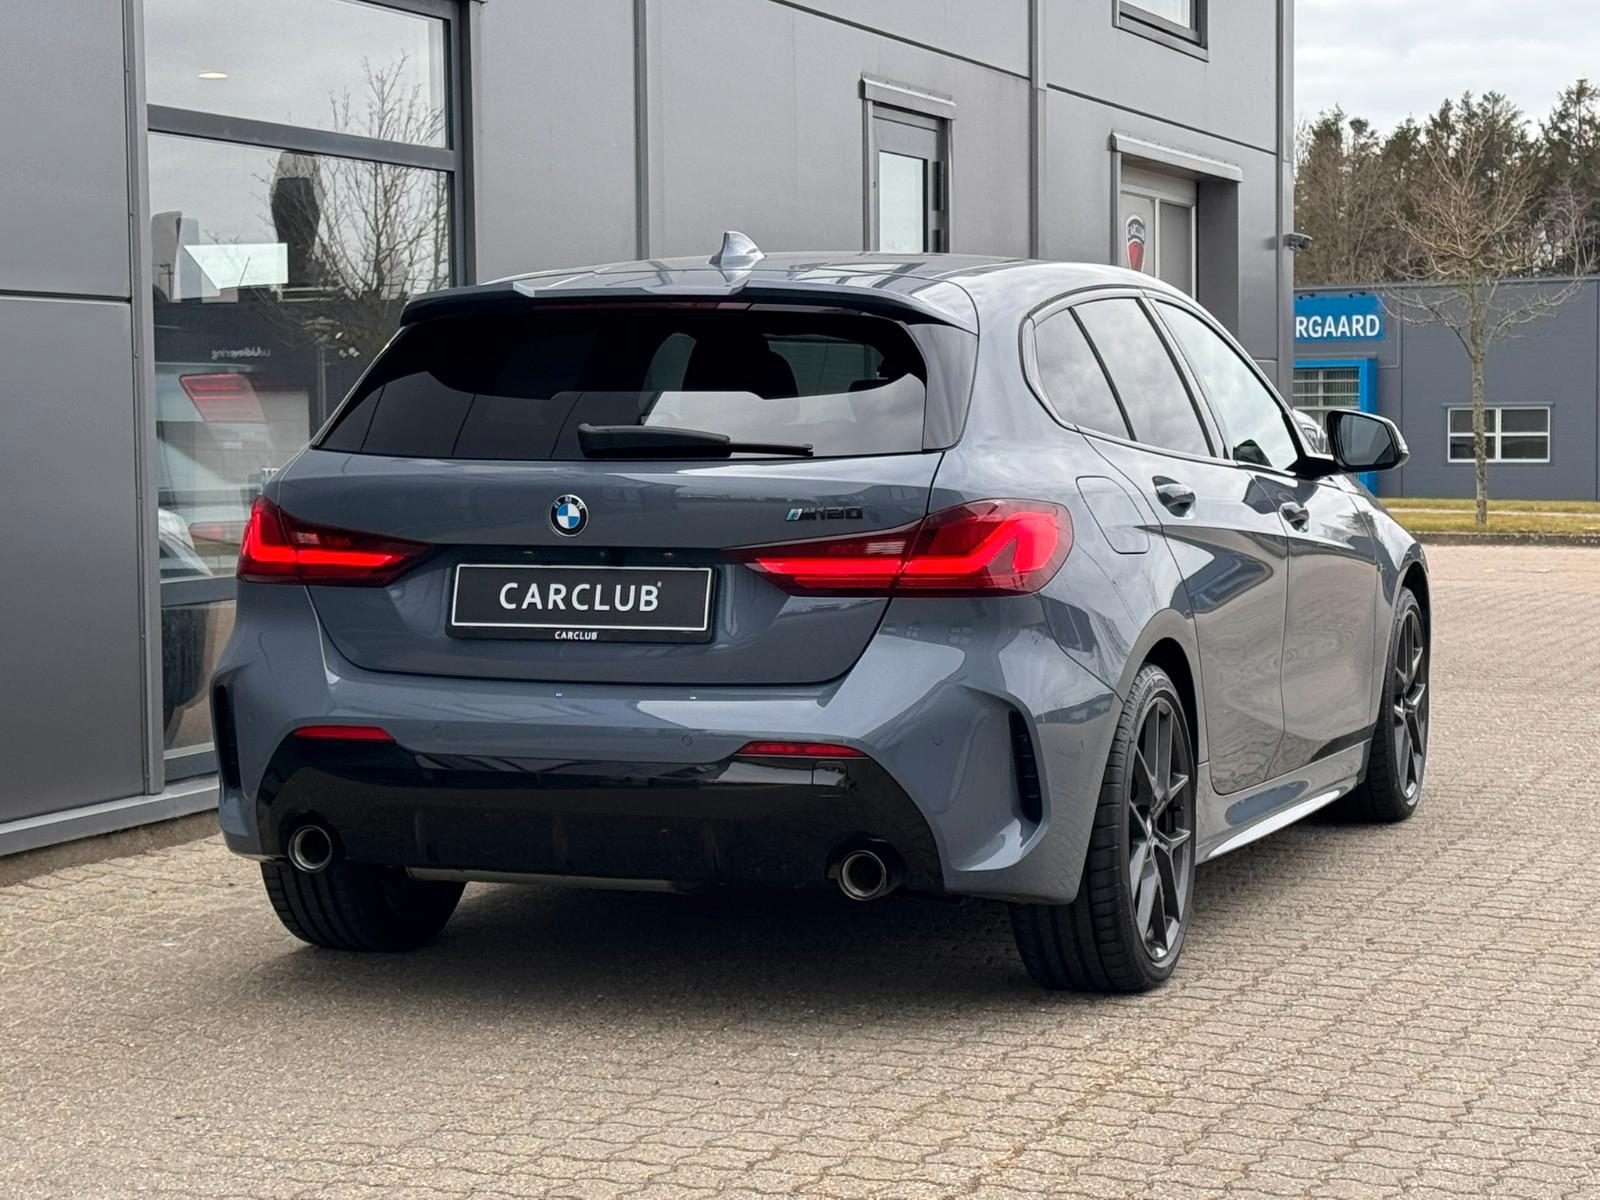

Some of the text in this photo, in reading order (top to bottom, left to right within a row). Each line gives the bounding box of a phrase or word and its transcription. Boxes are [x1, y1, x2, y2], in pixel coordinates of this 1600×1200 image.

[1295, 314, 1380, 338] RGAARD
[500, 582, 659, 612] CARCLUB
[555, 631, 598, 640] CARCLUB
